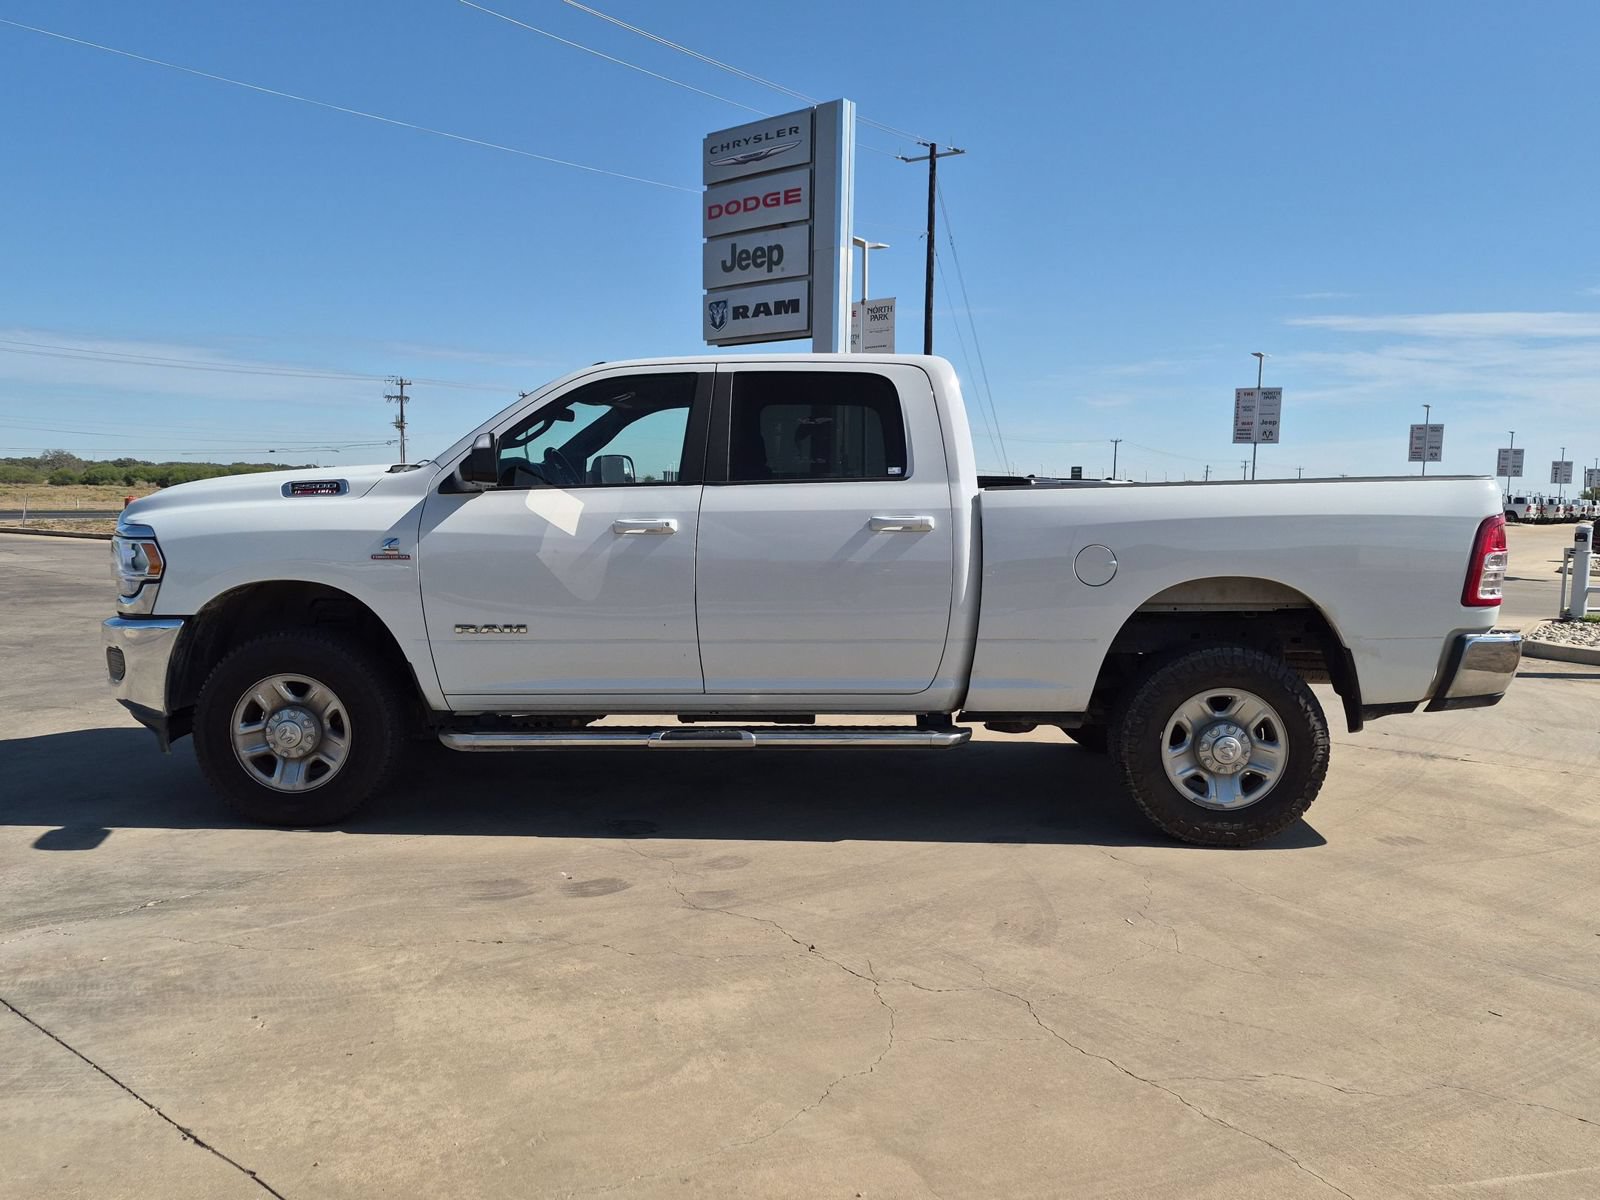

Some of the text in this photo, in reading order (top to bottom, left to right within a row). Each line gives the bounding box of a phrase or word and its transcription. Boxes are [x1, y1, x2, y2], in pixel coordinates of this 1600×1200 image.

[709, 126, 800, 155] CHRYSLER
[707, 188, 802, 220] DODGE
[721, 242, 784, 273] Jeep
[732, 298, 800, 320] RAM
[866, 305, 893, 315] NORTH
[870, 313, 889, 321] PARK
[455, 624, 527, 633] RAM
